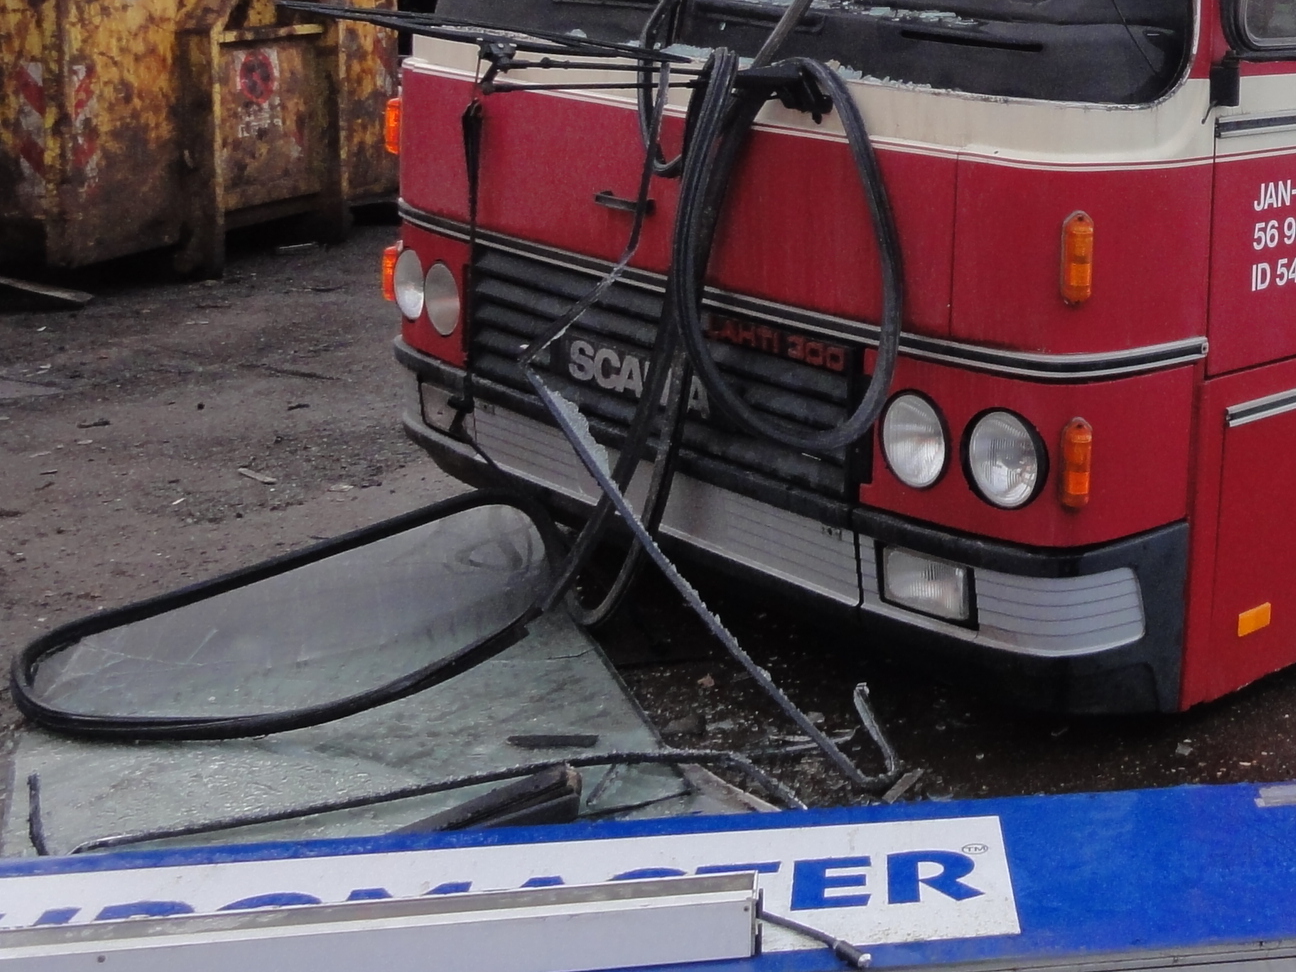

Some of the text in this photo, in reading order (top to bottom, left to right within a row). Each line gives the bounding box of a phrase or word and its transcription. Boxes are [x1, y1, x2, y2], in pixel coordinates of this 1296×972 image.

[1252, 219, 1279, 250] 56
[1251, 261, 1271, 292] ID
[786, 334, 845, 373] 300
[568, 339, 710, 419] SCAA
